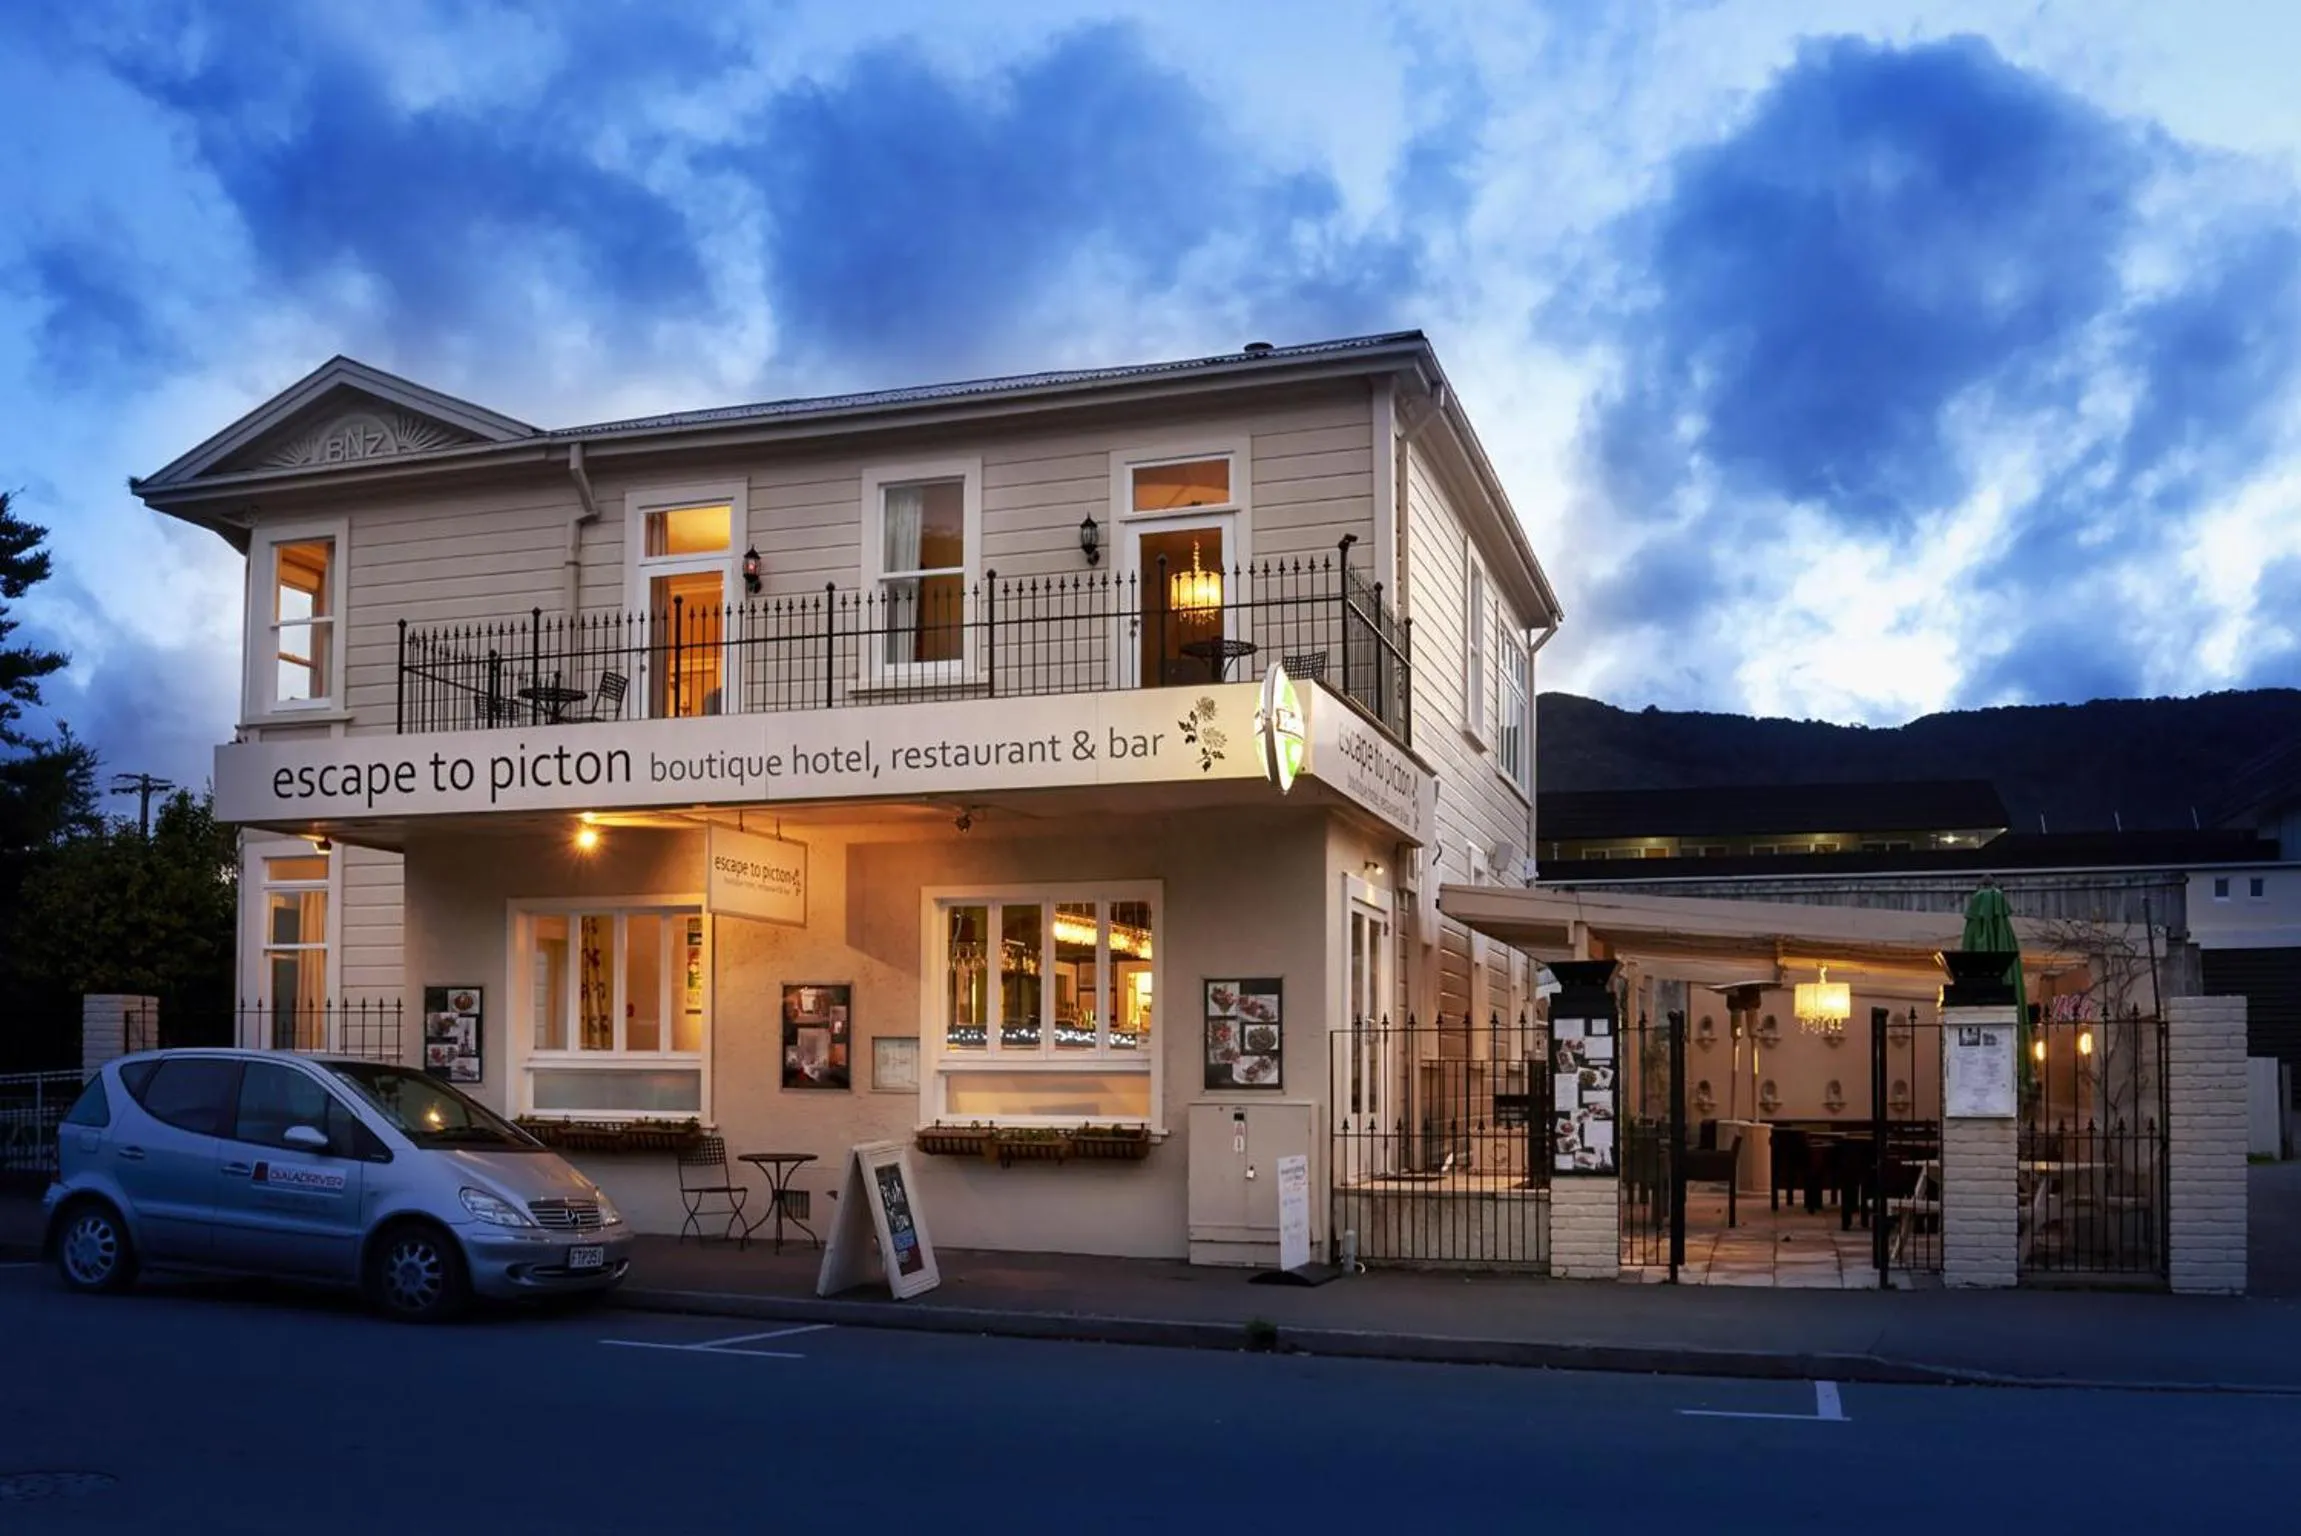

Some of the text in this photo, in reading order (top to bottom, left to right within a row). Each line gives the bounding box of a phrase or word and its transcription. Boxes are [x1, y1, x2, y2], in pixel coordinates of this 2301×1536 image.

[325, 424, 387, 462] BNZ
[272, 726, 1165, 809] escape to picton boutique hotel, restaurant & bar
[714, 855, 791, 883] escape to picton
